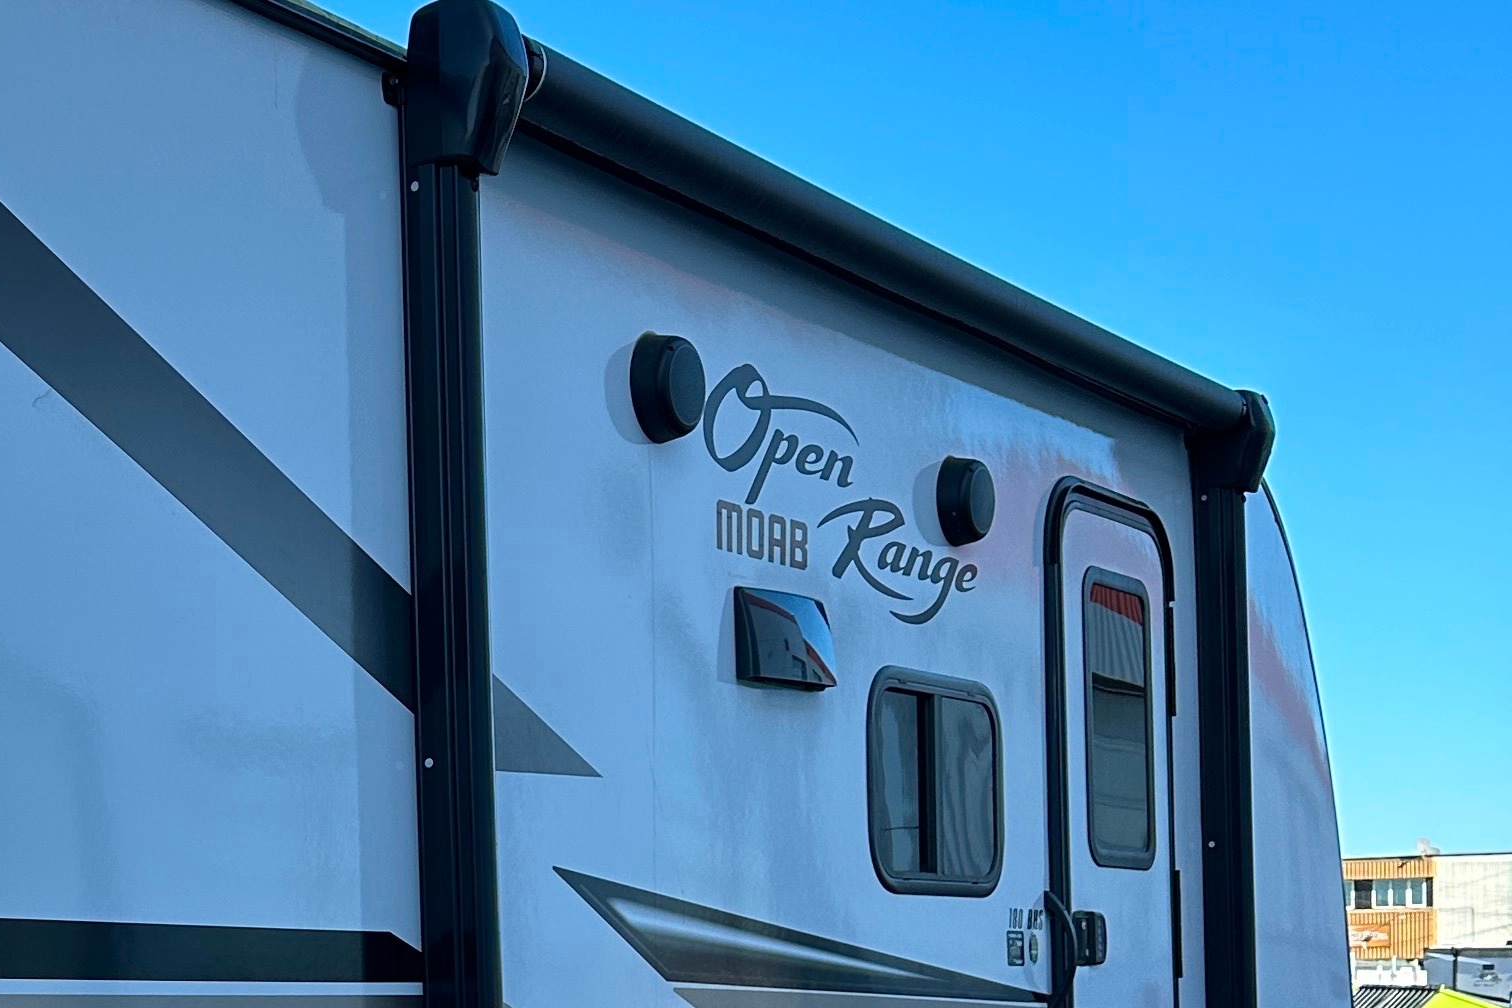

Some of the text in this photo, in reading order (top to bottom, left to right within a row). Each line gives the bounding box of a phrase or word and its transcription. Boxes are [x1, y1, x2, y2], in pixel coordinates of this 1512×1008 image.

[703, 363, 860, 504] Open
[716, 499, 808, 571] MOAB
[817, 497, 979, 625] Range
